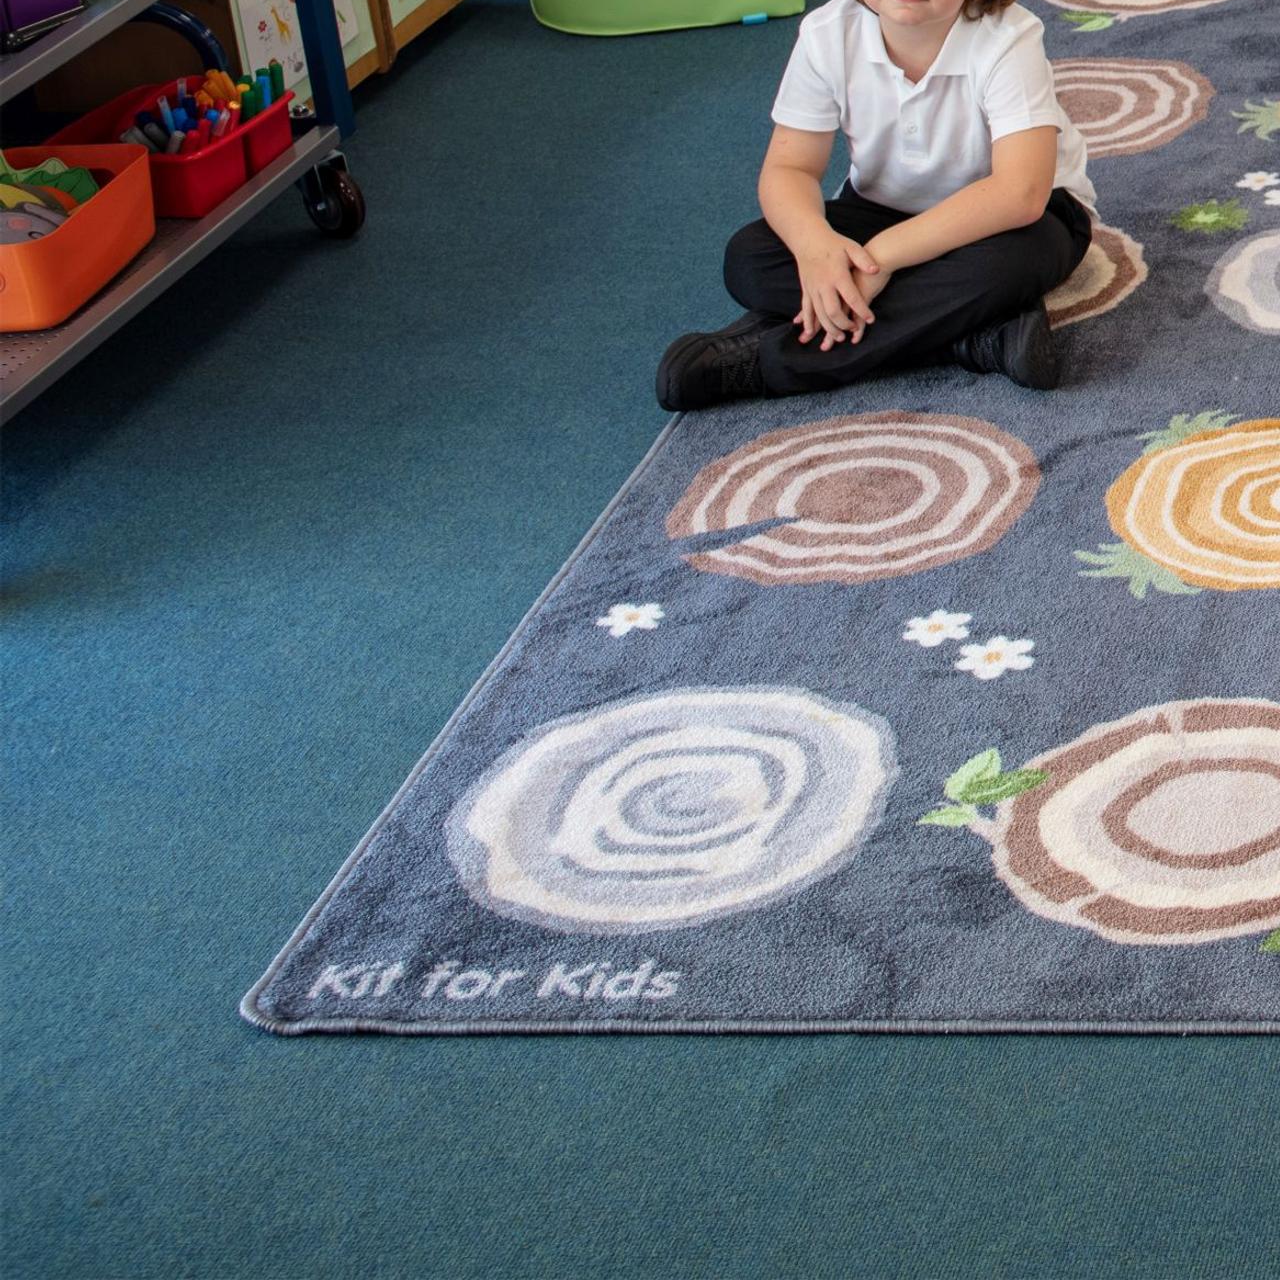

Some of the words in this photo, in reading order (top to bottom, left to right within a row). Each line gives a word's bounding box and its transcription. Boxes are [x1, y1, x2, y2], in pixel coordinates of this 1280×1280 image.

[307, 959, 403, 1001] Kit
[421, 958, 528, 1001] for
[536, 958, 683, 1002] Kids
